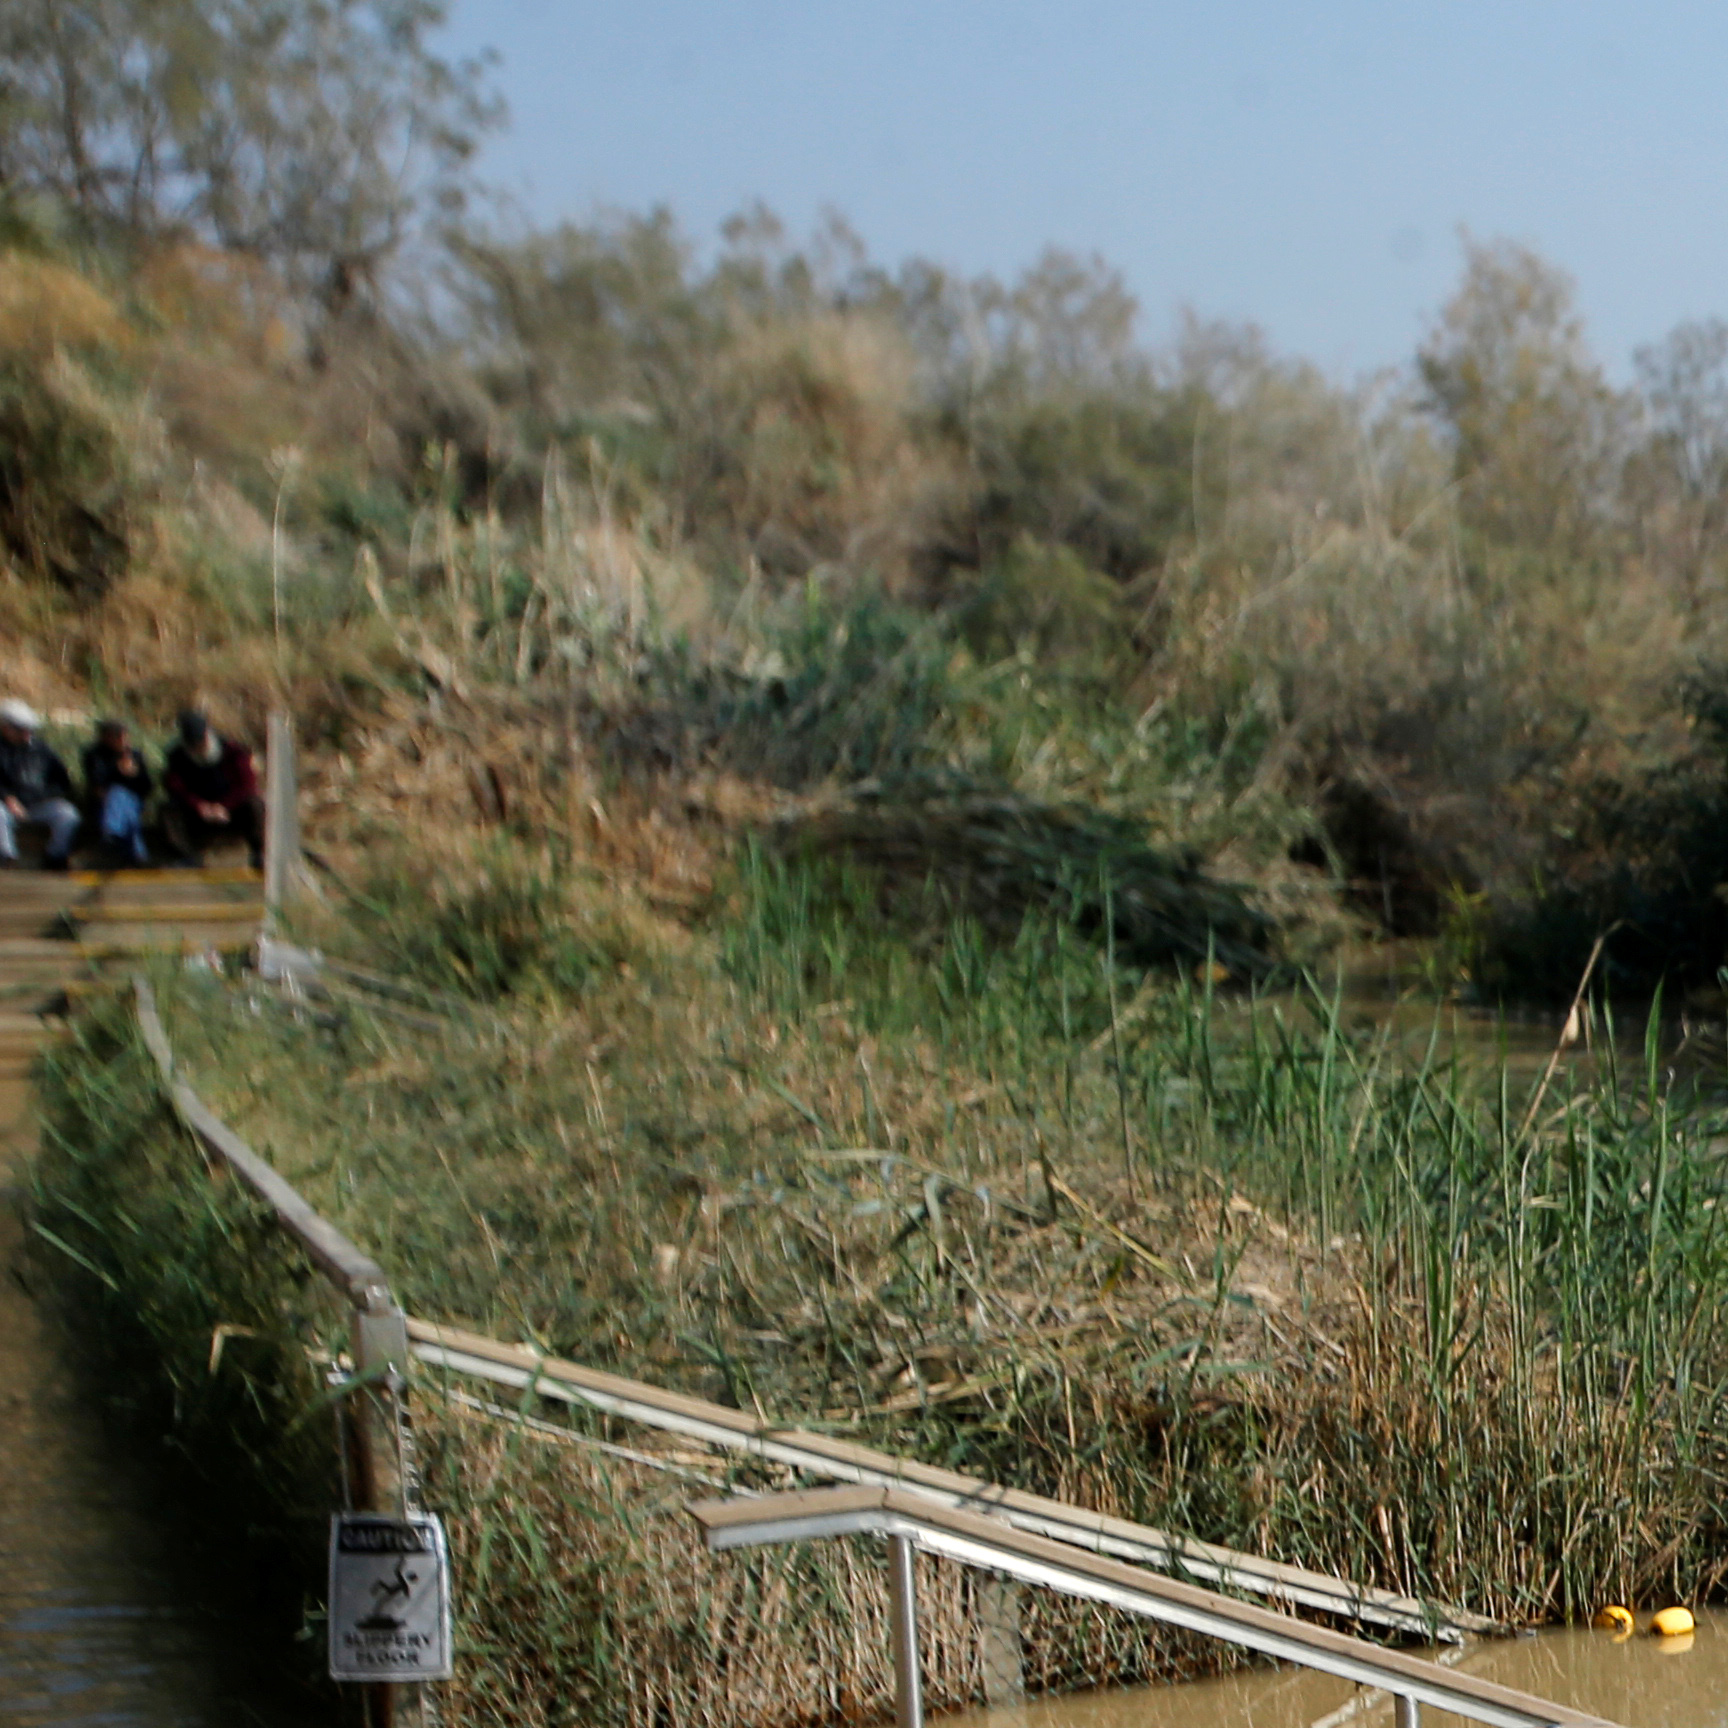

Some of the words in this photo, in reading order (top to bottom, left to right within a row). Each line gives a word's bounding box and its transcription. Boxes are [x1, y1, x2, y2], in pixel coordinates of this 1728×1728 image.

[342, 1526, 432, 1549] CAUTION
[344, 1632, 431, 1649] SLIPPERY
[356, 1650, 420, 1666] FLOOR
